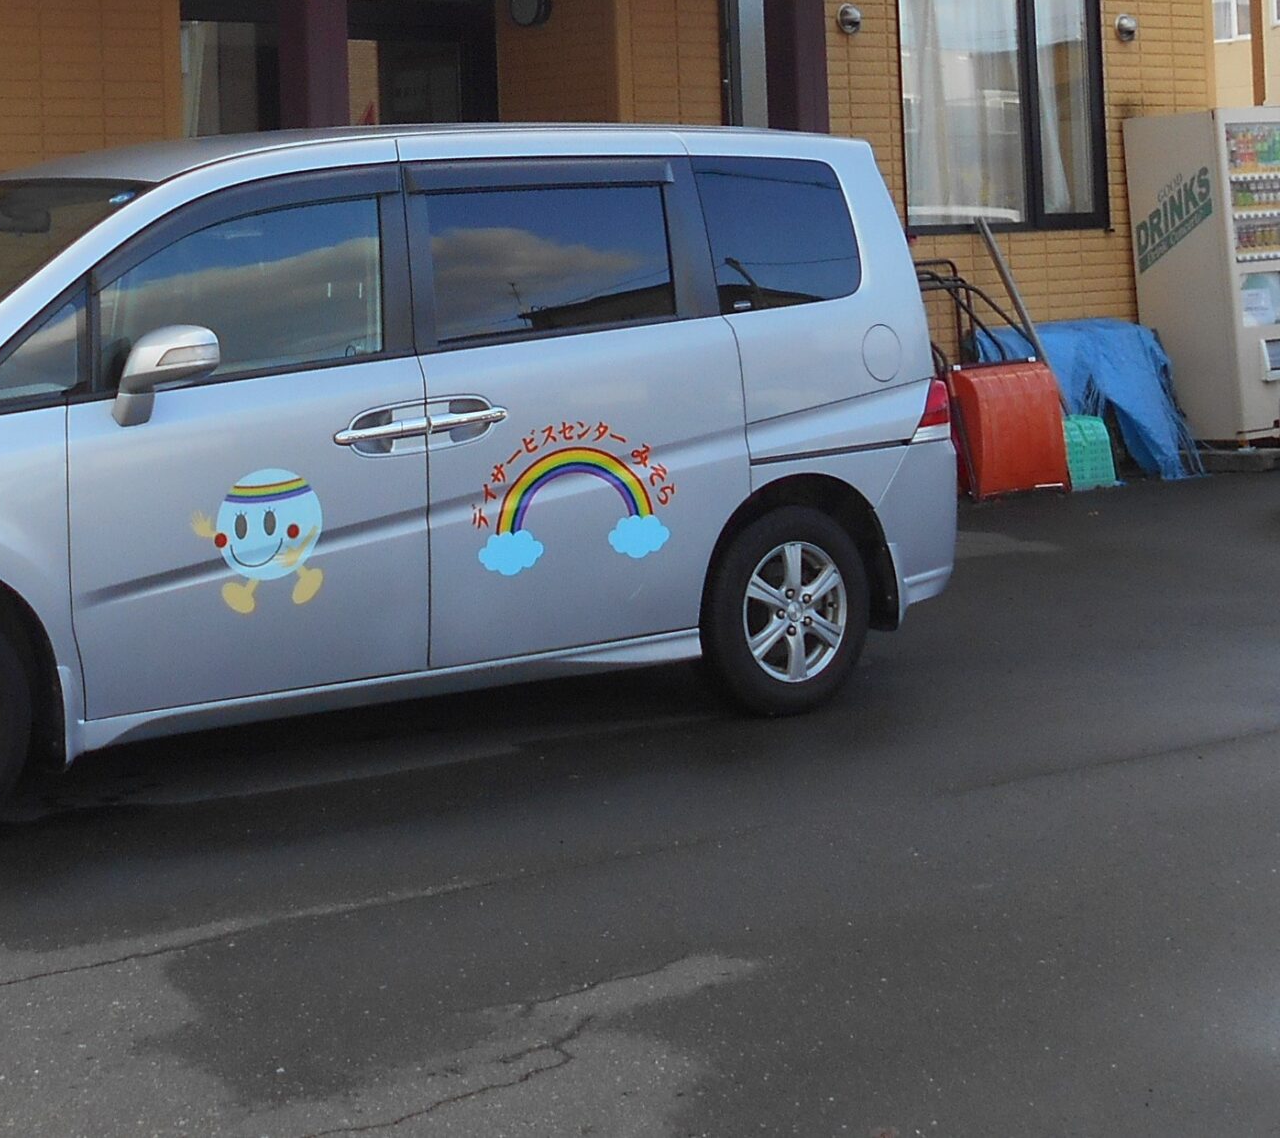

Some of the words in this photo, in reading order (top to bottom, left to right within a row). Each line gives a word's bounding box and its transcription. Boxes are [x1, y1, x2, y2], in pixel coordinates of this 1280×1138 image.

[1135, 166, 1211, 256] DRINKS
[631, 444, 675, 505] みそら
